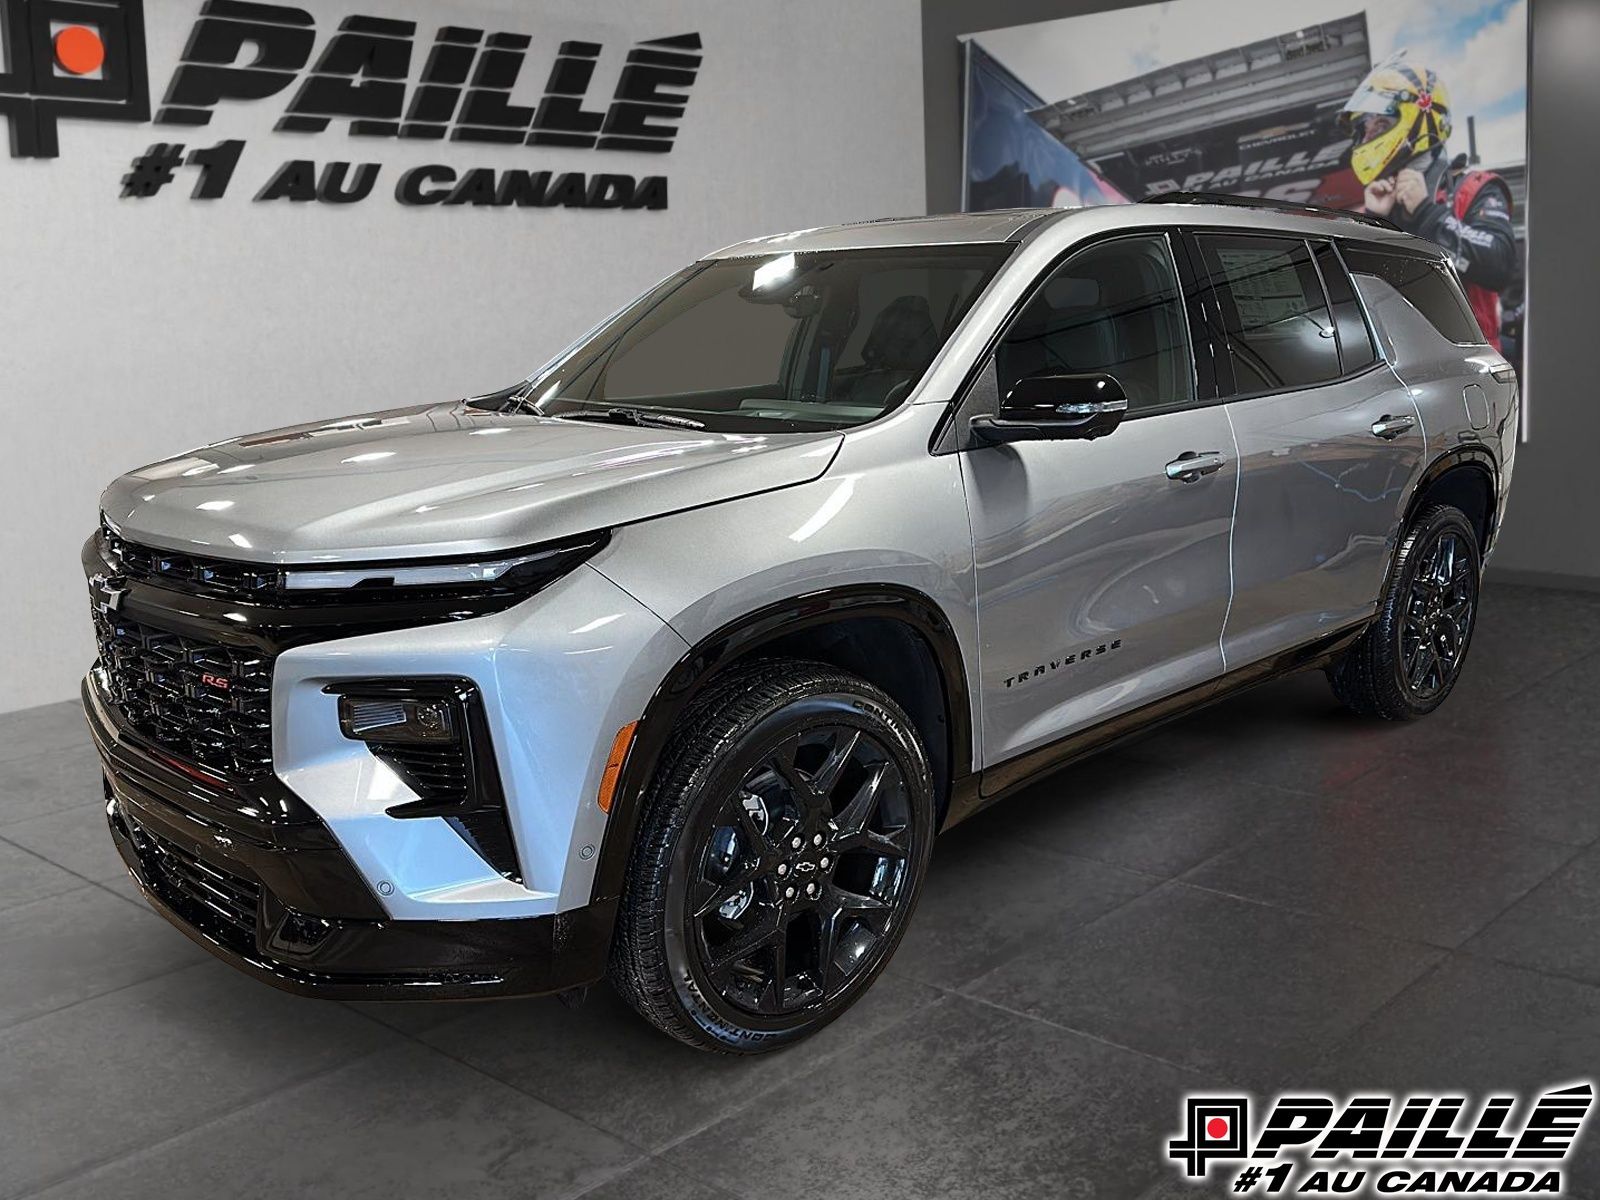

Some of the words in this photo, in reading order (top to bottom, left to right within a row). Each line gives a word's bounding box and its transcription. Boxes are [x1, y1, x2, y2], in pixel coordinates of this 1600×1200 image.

[152, 0, 703, 153] PAILLÉ
[1239, 129, 1317, 151] CHEVROLET
[119, 139, 246, 200] #1
[252, 159, 382, 203] AU
[395, 164, 668, 210] CANADA
[1244, 158, 1340, 183] CANADA
[202, 674, 228, 688] RS
[1003, 639, 1122, 688] TRAVERSE
